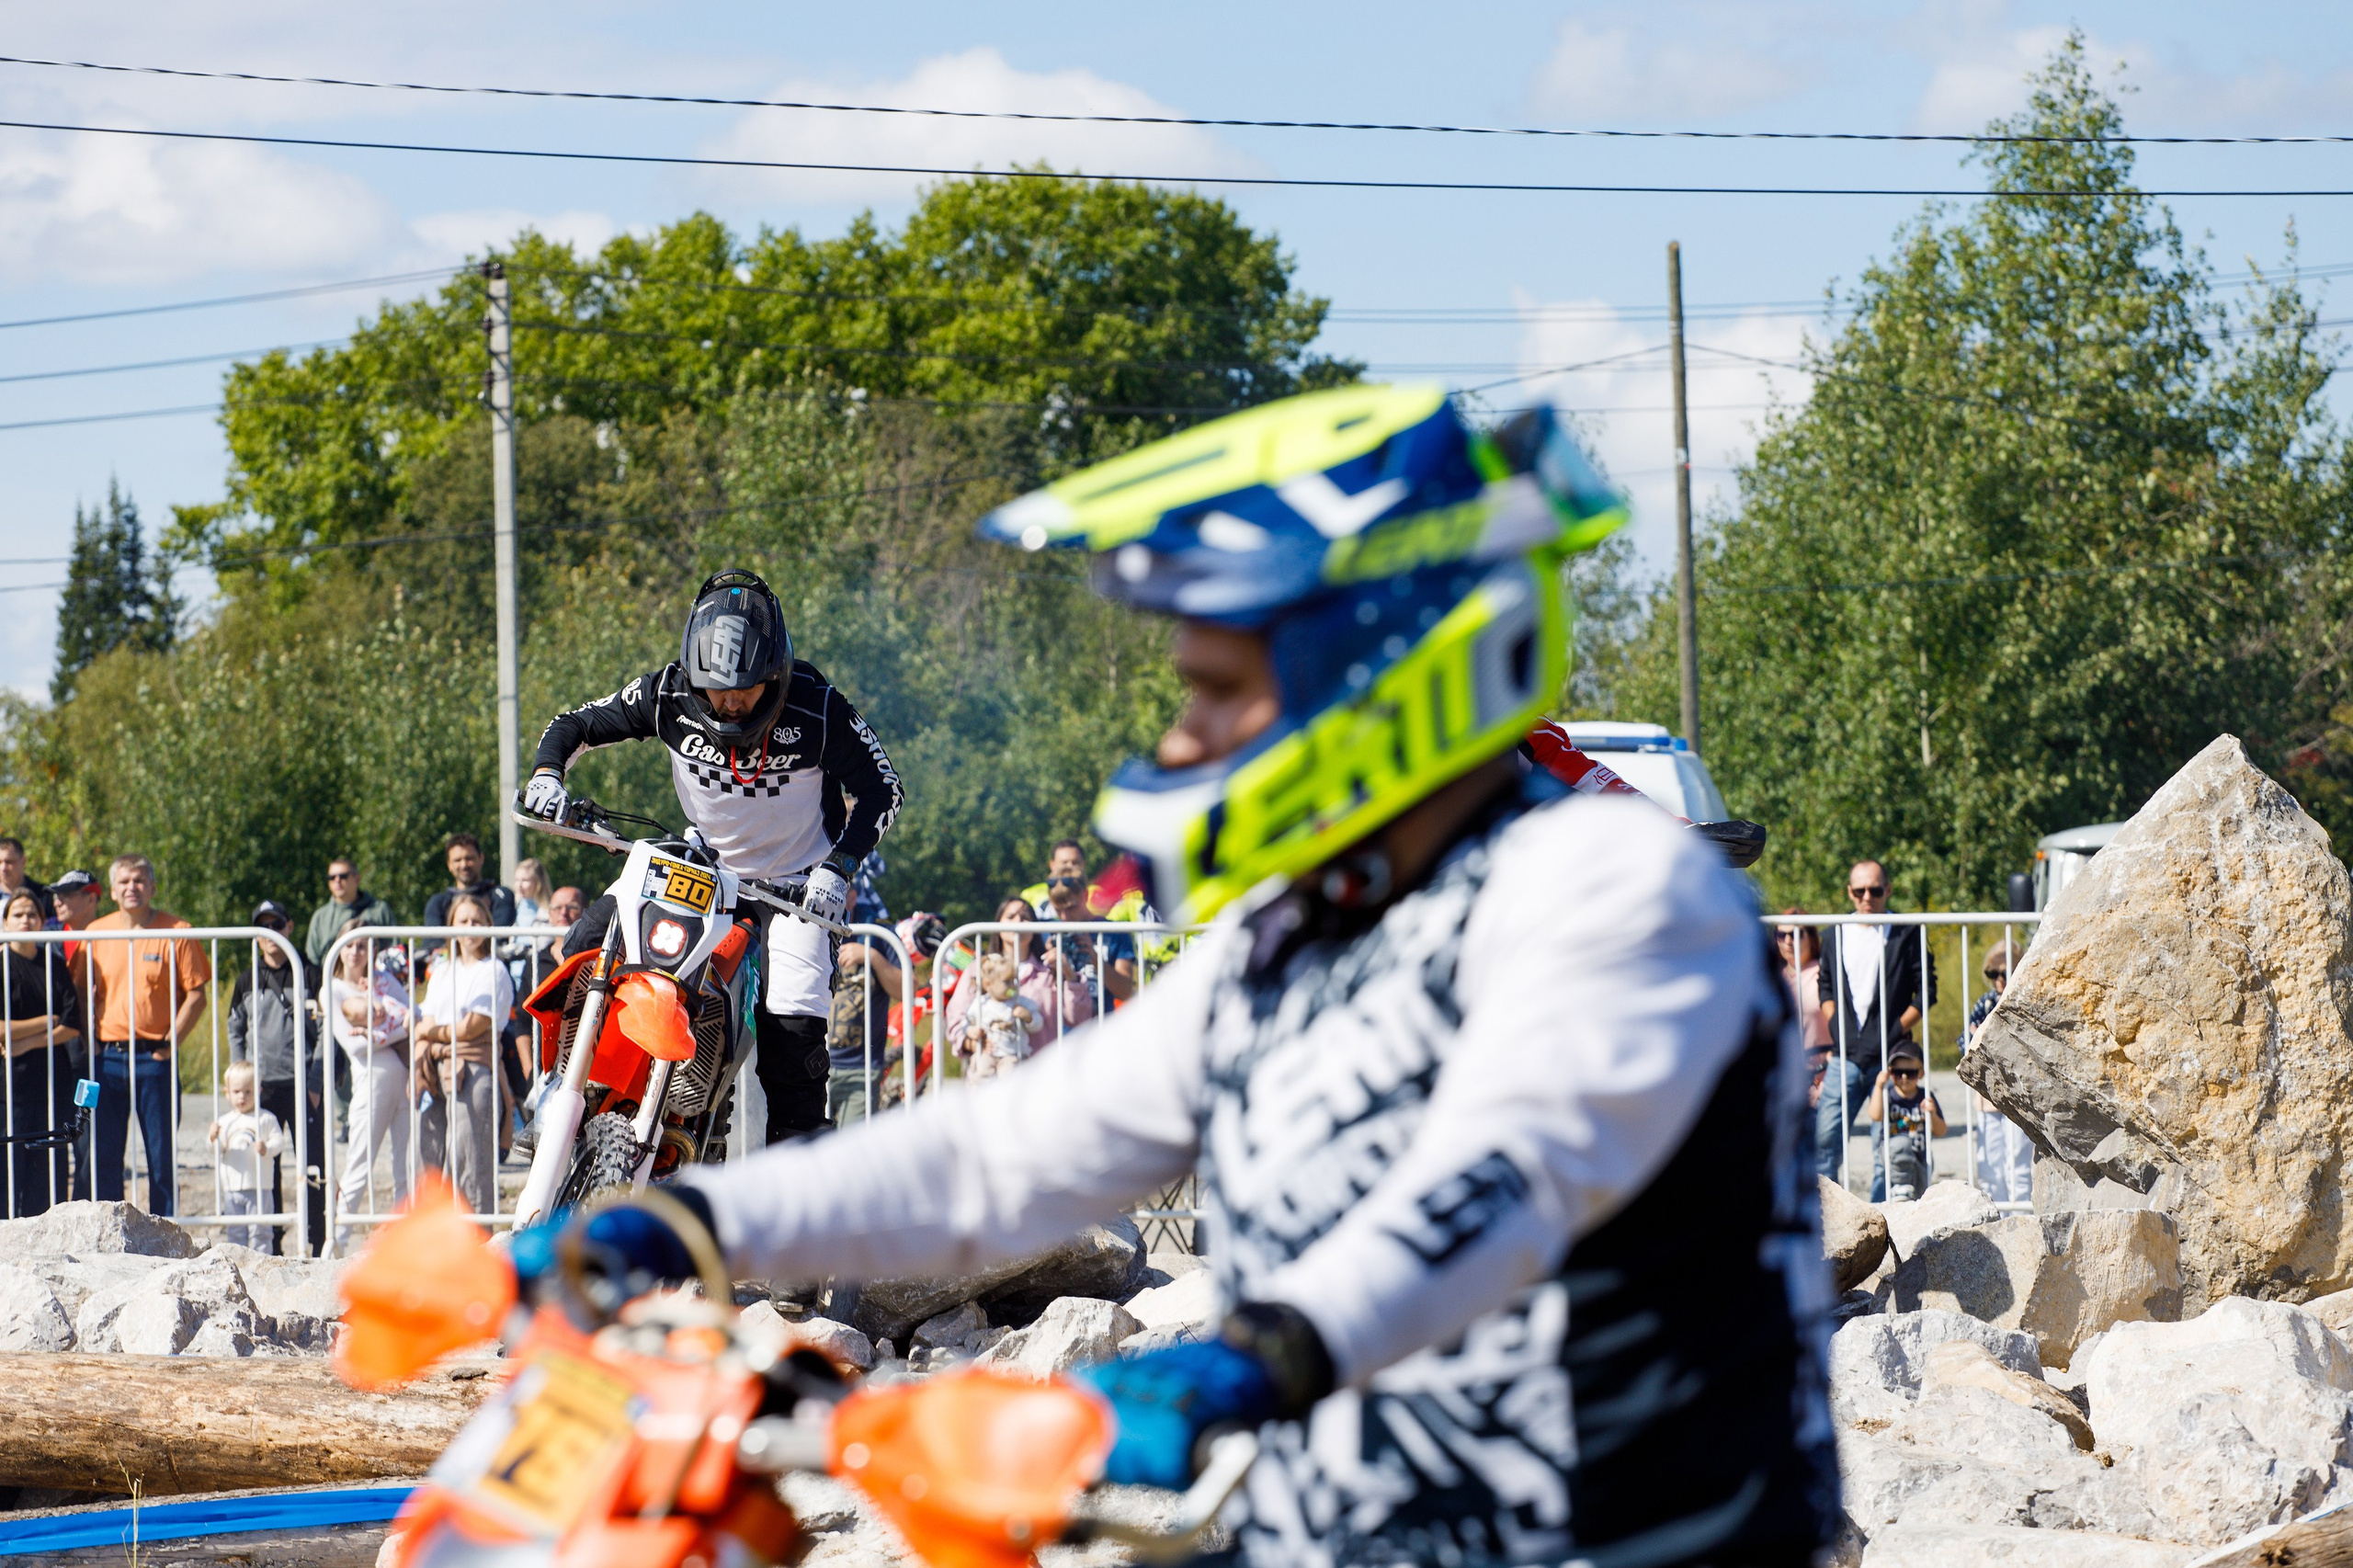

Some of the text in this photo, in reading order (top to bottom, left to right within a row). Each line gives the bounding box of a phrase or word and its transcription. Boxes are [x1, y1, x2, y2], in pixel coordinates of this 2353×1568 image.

[679, 733, 725, 766] Gas
[773, 726, 801, 742] 805
[665, 872, 713, 910] 80
